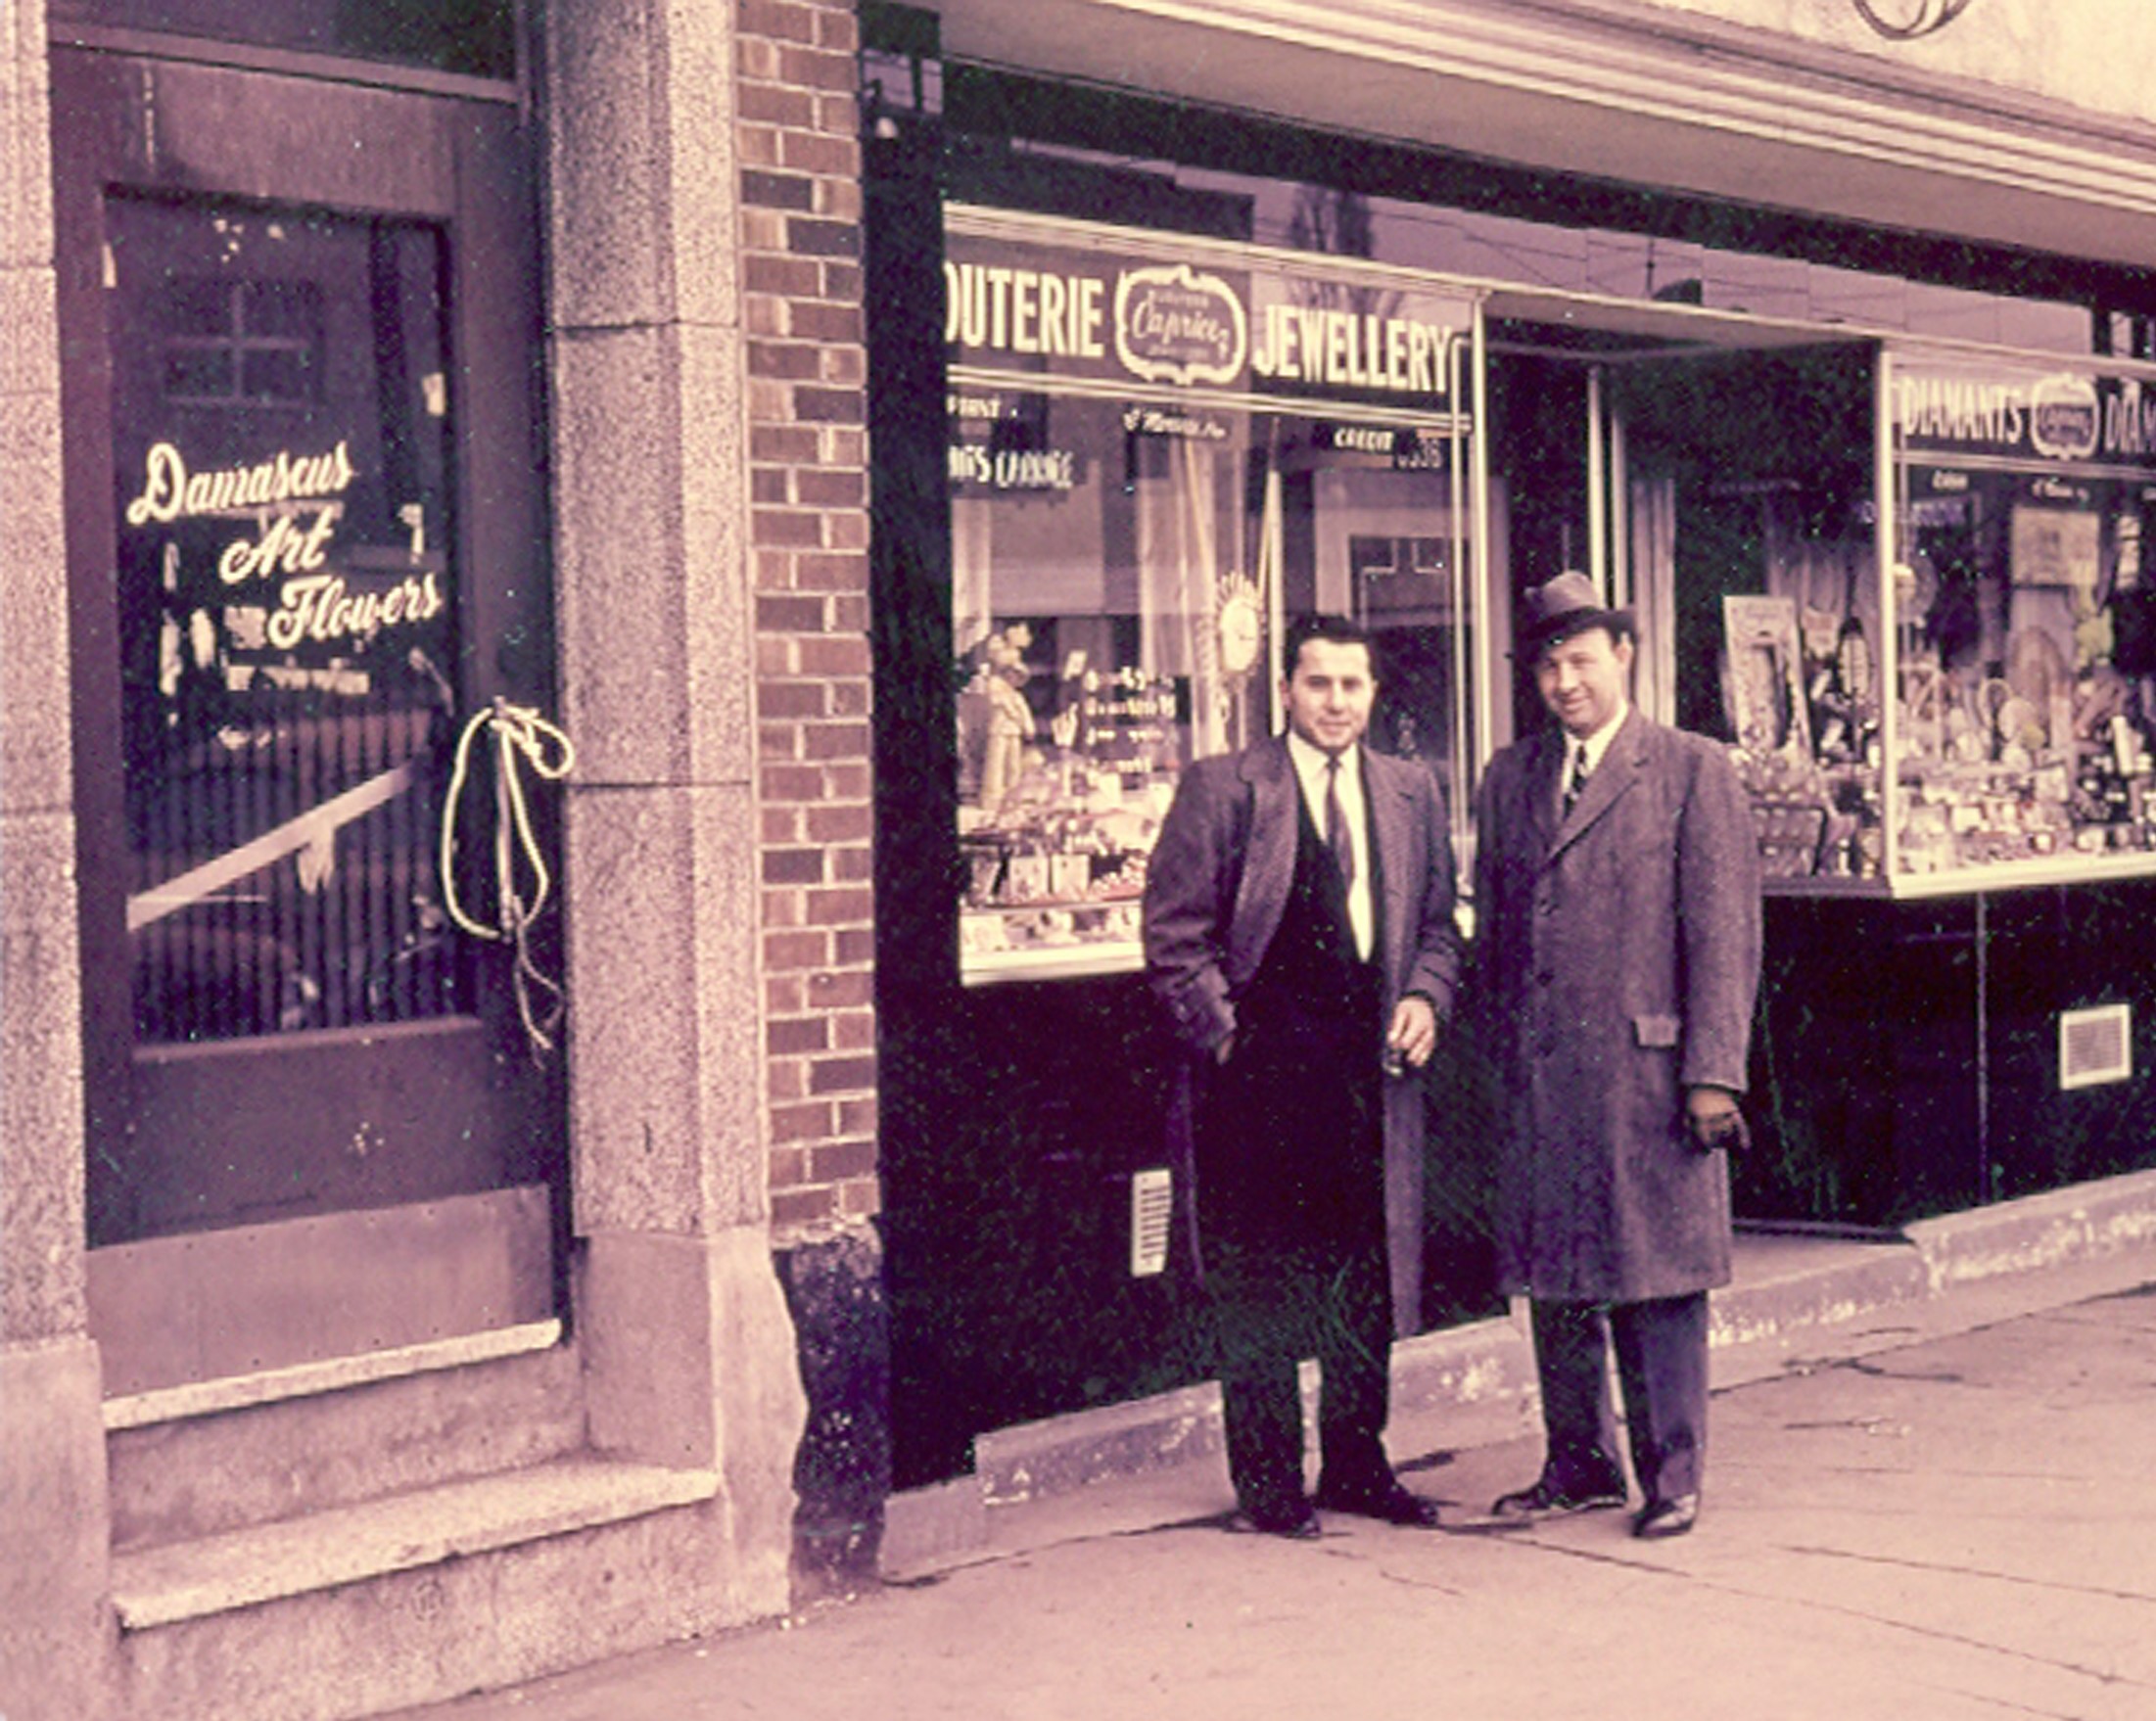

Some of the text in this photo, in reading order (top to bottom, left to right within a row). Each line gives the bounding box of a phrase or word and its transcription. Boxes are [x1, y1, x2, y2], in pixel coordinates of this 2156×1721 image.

[1252, 304, 1451, 393] JEWELLERY
[126, 440, 355, 526] Damascus
[218, 501, 335, 584] Art
[267, 572, 442, 649] Flowers
